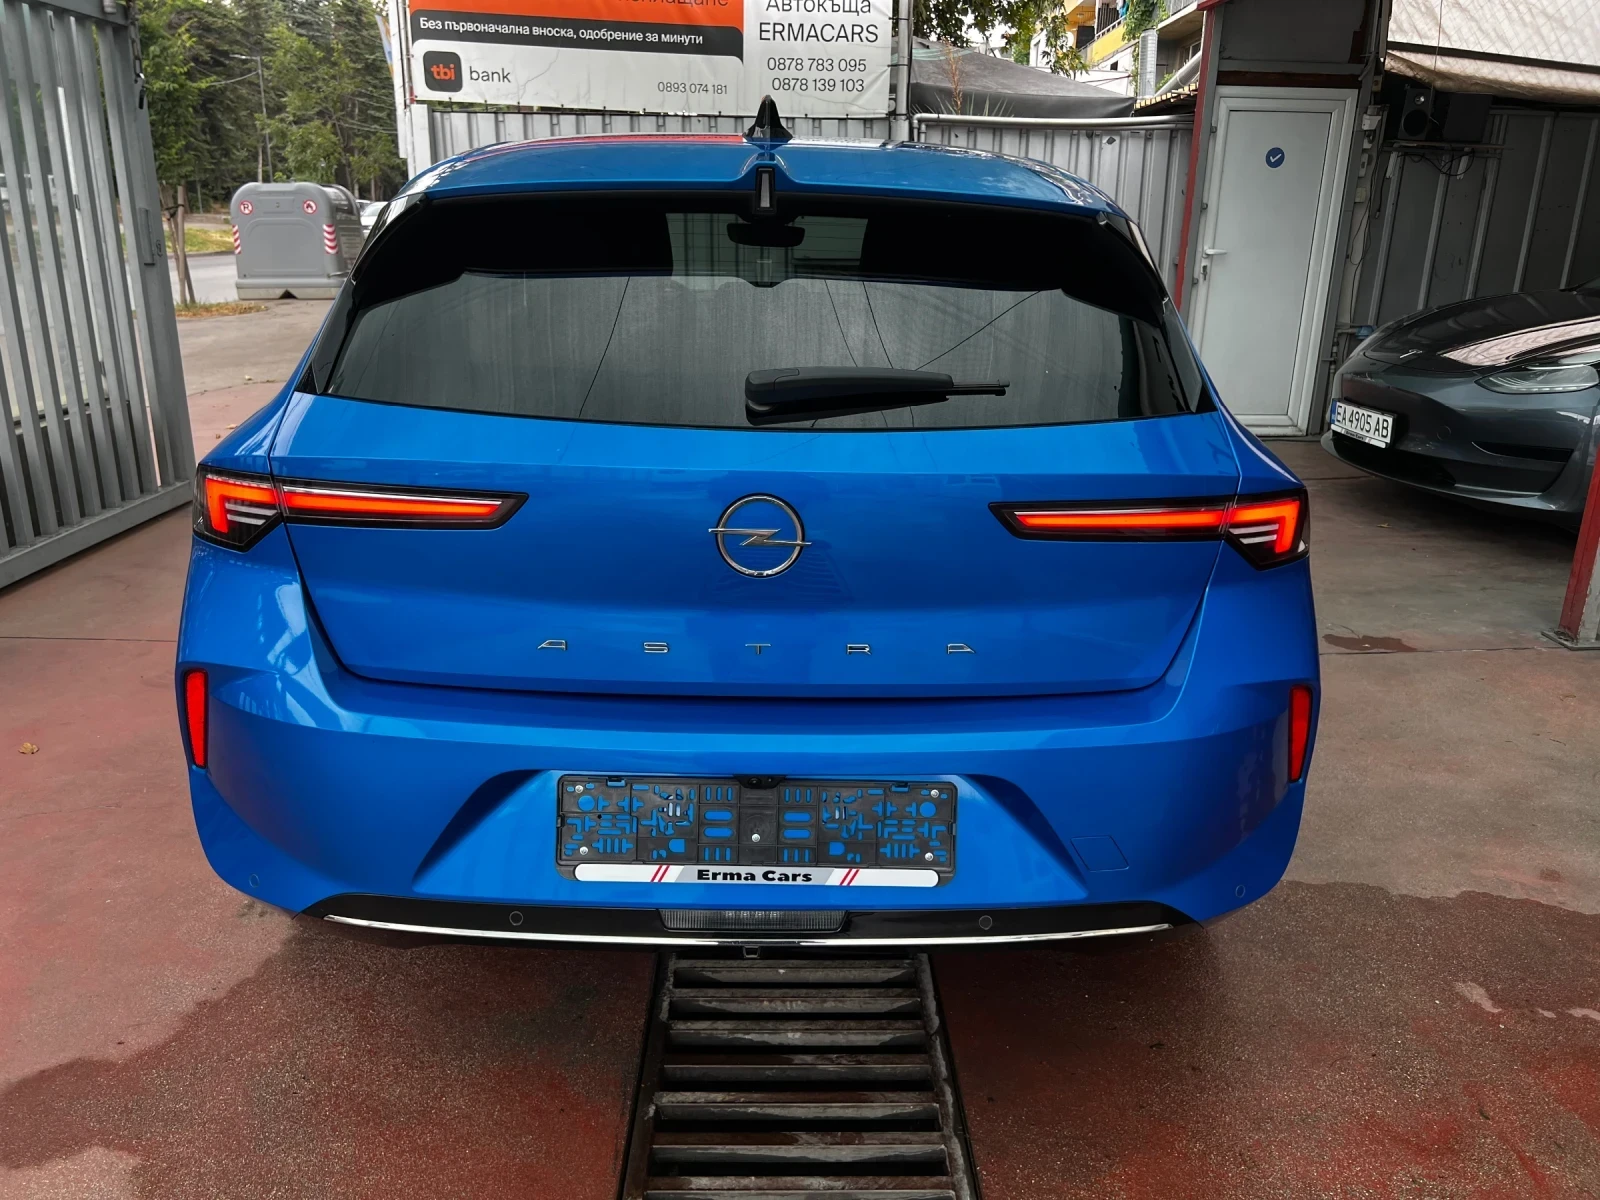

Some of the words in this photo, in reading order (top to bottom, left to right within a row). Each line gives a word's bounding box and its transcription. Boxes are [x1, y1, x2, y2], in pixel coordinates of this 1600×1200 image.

[419, 17, 442, 30] Без
[444, 20, 530, 35] първоначална
[532, 26, 577, 39] вноска,
[579, 28, 643, 42] одобрение
[645, 33, 659, 42] за
[661, 33, 703, 45] минути
[759, 22, 879, 43] ERMACARS
[430, 63, 456, 80] tbi
[767, 57, 804, 71] 0878
[807, 58, 834, 72] 783
[838, 59, 867, 72] 095
[469, 66, 511, 83] bank
[657, 81, 687, 93] 0893
[689, 83, 709, 94] 074
[712, 84, 728, 95] 181
[771, 77, 809, 91] 0878
[812, 78, 836, 92] 139
[840, 78, 865, 92] 103
[1336, 404, 1347, 426] EA
[1348, 409, 1372, 433] 4905
[1373, 416, 1389, 439] AB
[537, 639, 975, 656] ASTRA
[697, 869, 756, 881] Erma
[762, 870, 812, 882] Cars
